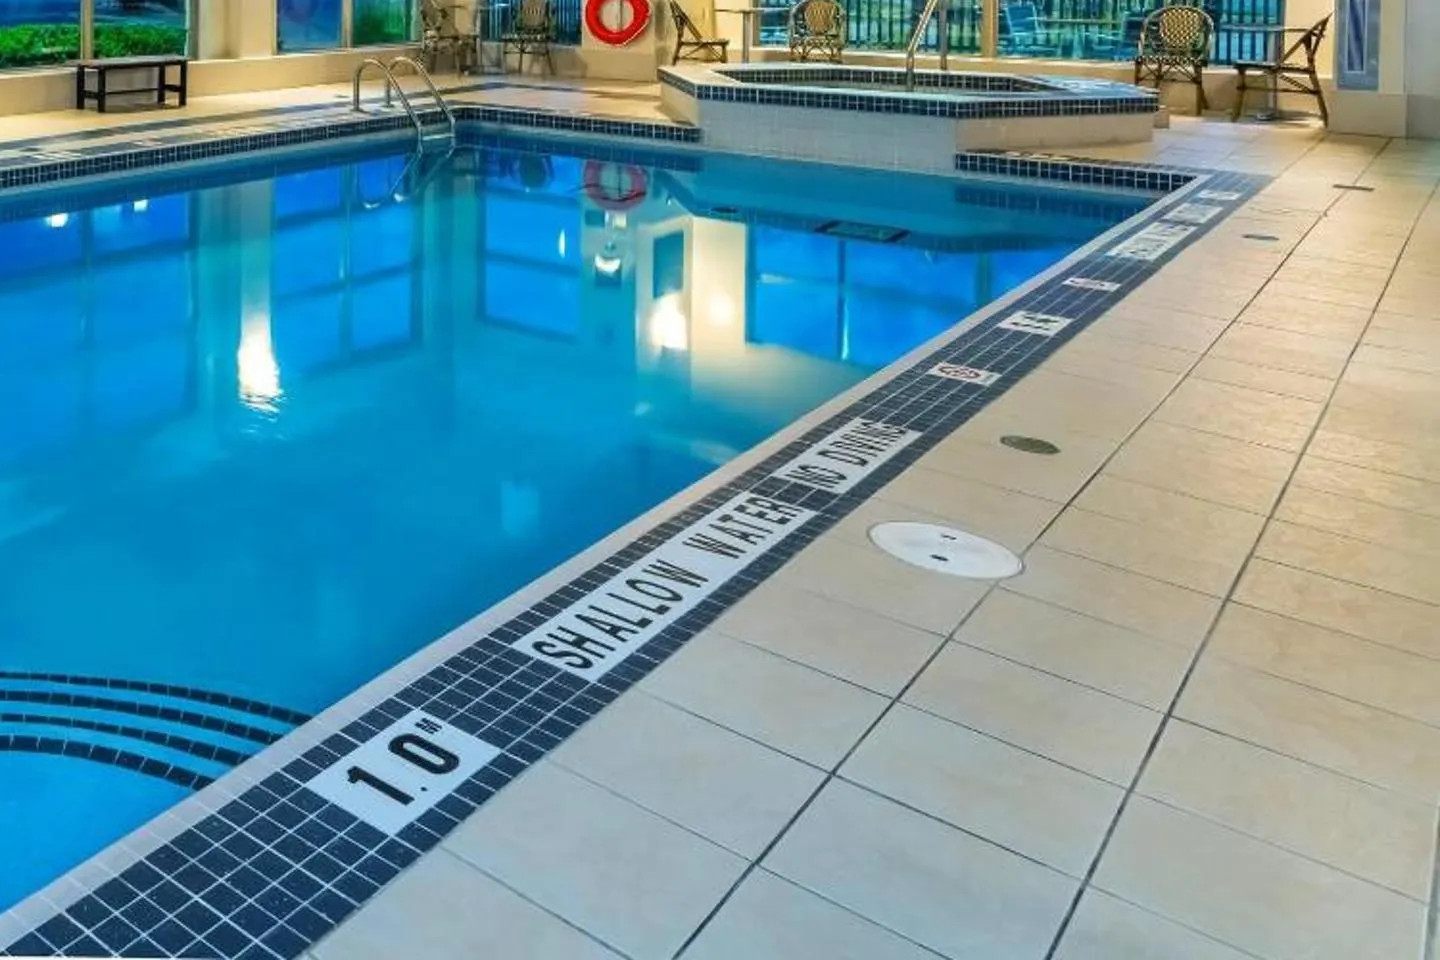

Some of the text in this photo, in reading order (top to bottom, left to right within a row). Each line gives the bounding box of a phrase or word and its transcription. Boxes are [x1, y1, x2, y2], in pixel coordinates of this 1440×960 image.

[785, 464, 848, 488] NO
[531, 496, 805, 670] SHALLOW WATER
[346, 733, 460, 806] 1.0
